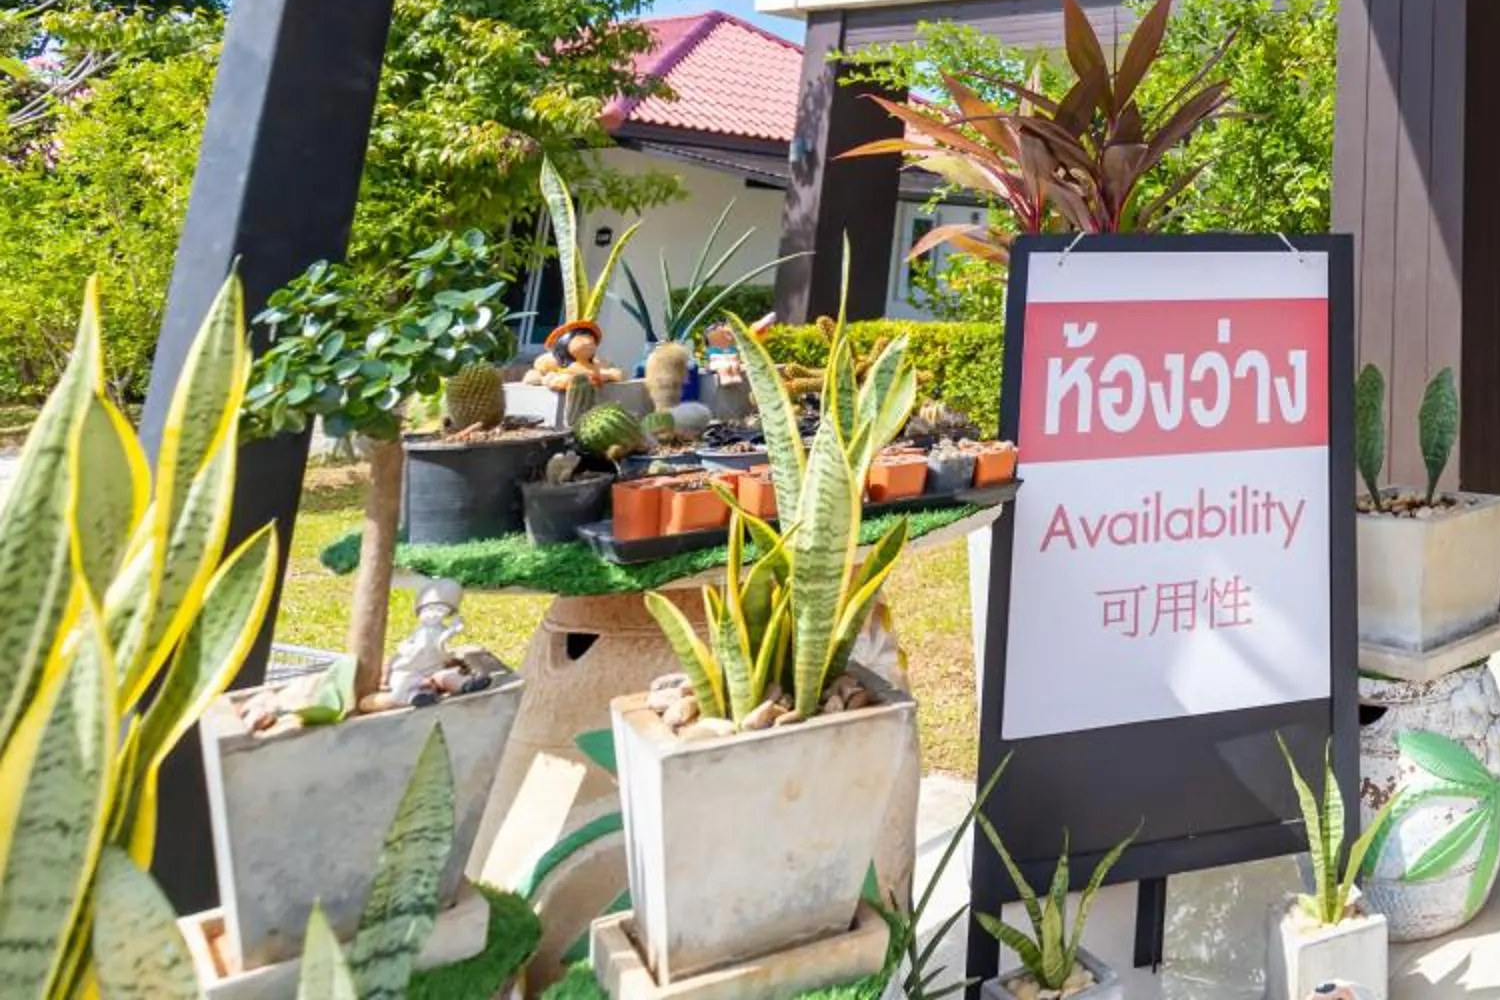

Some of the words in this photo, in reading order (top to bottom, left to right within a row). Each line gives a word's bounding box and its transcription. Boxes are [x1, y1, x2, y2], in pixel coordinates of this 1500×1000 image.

[1045, 319, 1307, 435] ห้องว่าง
[1039, 486, 1305, 551] Availability
[1096, 575, 1253, 637] 可用性
